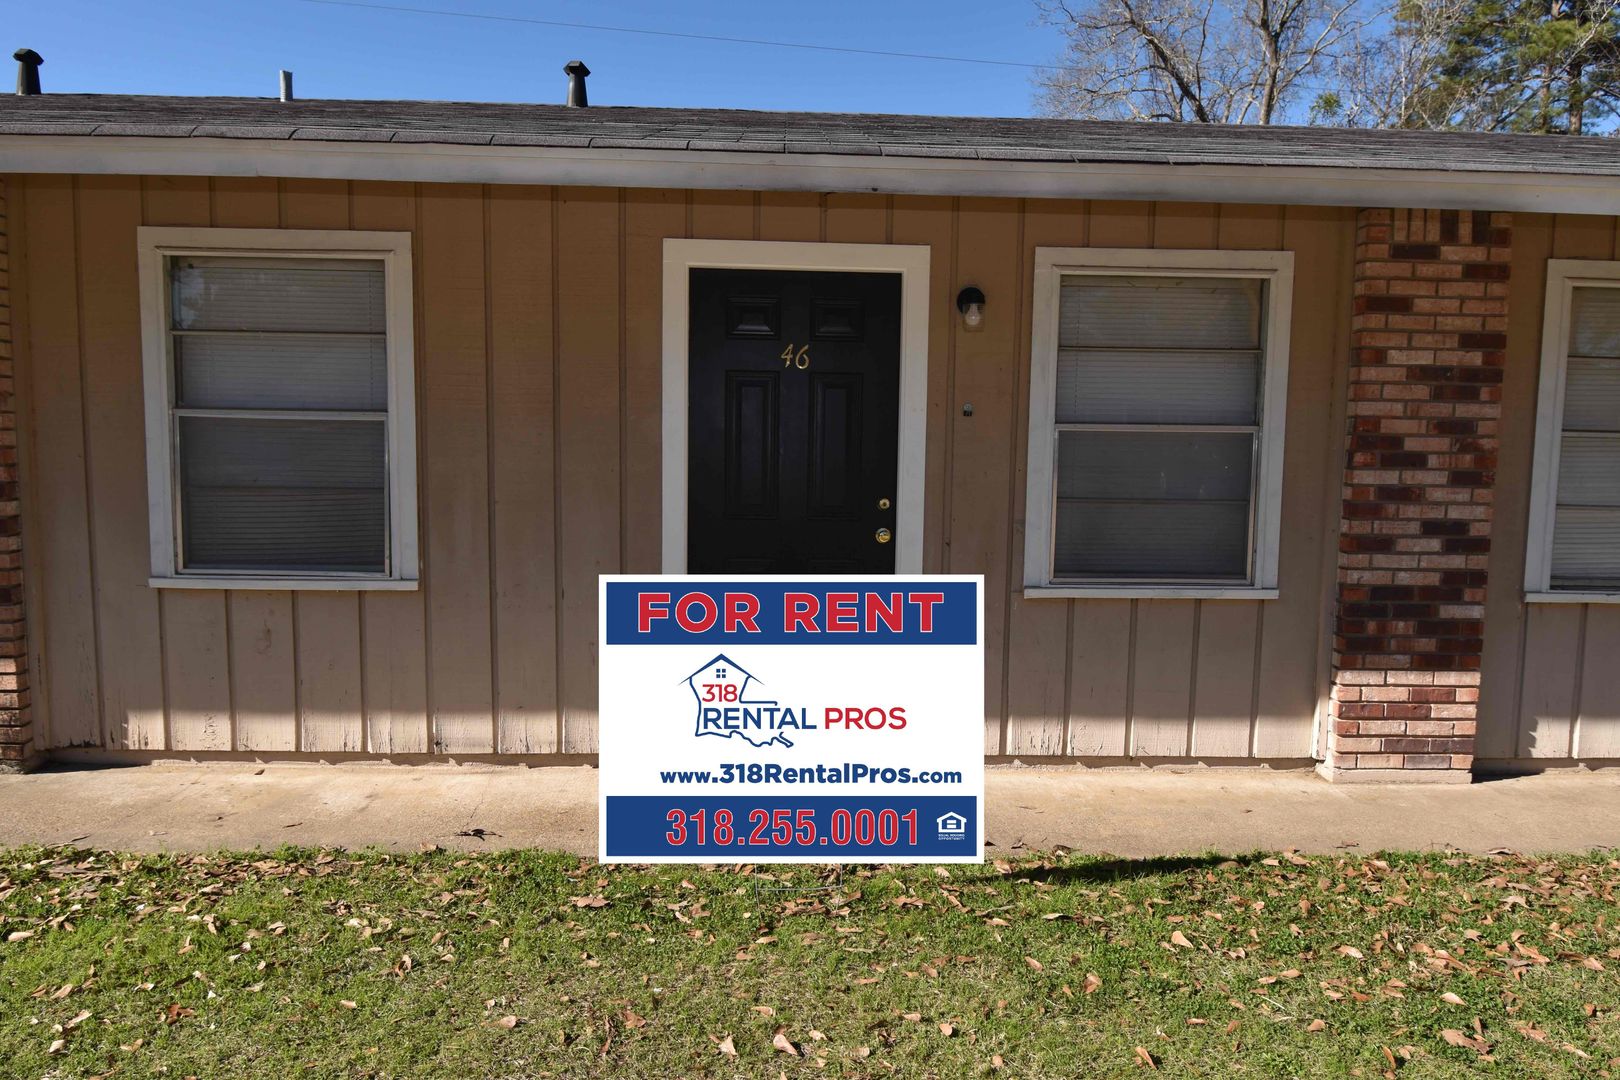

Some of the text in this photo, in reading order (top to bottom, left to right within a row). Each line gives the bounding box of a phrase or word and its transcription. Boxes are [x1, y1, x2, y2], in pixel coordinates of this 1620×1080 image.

[780, 343, 810, 370] 46
[637, 592, 945, 633] FOR RENT
[702, 684, 738, 702] 318
[703, 707, 907, 730] RENTAL PROS
[660, 763, 962, 784] www.318RentalPros.com
[666, 809, 918, 846] 318.255.0001
